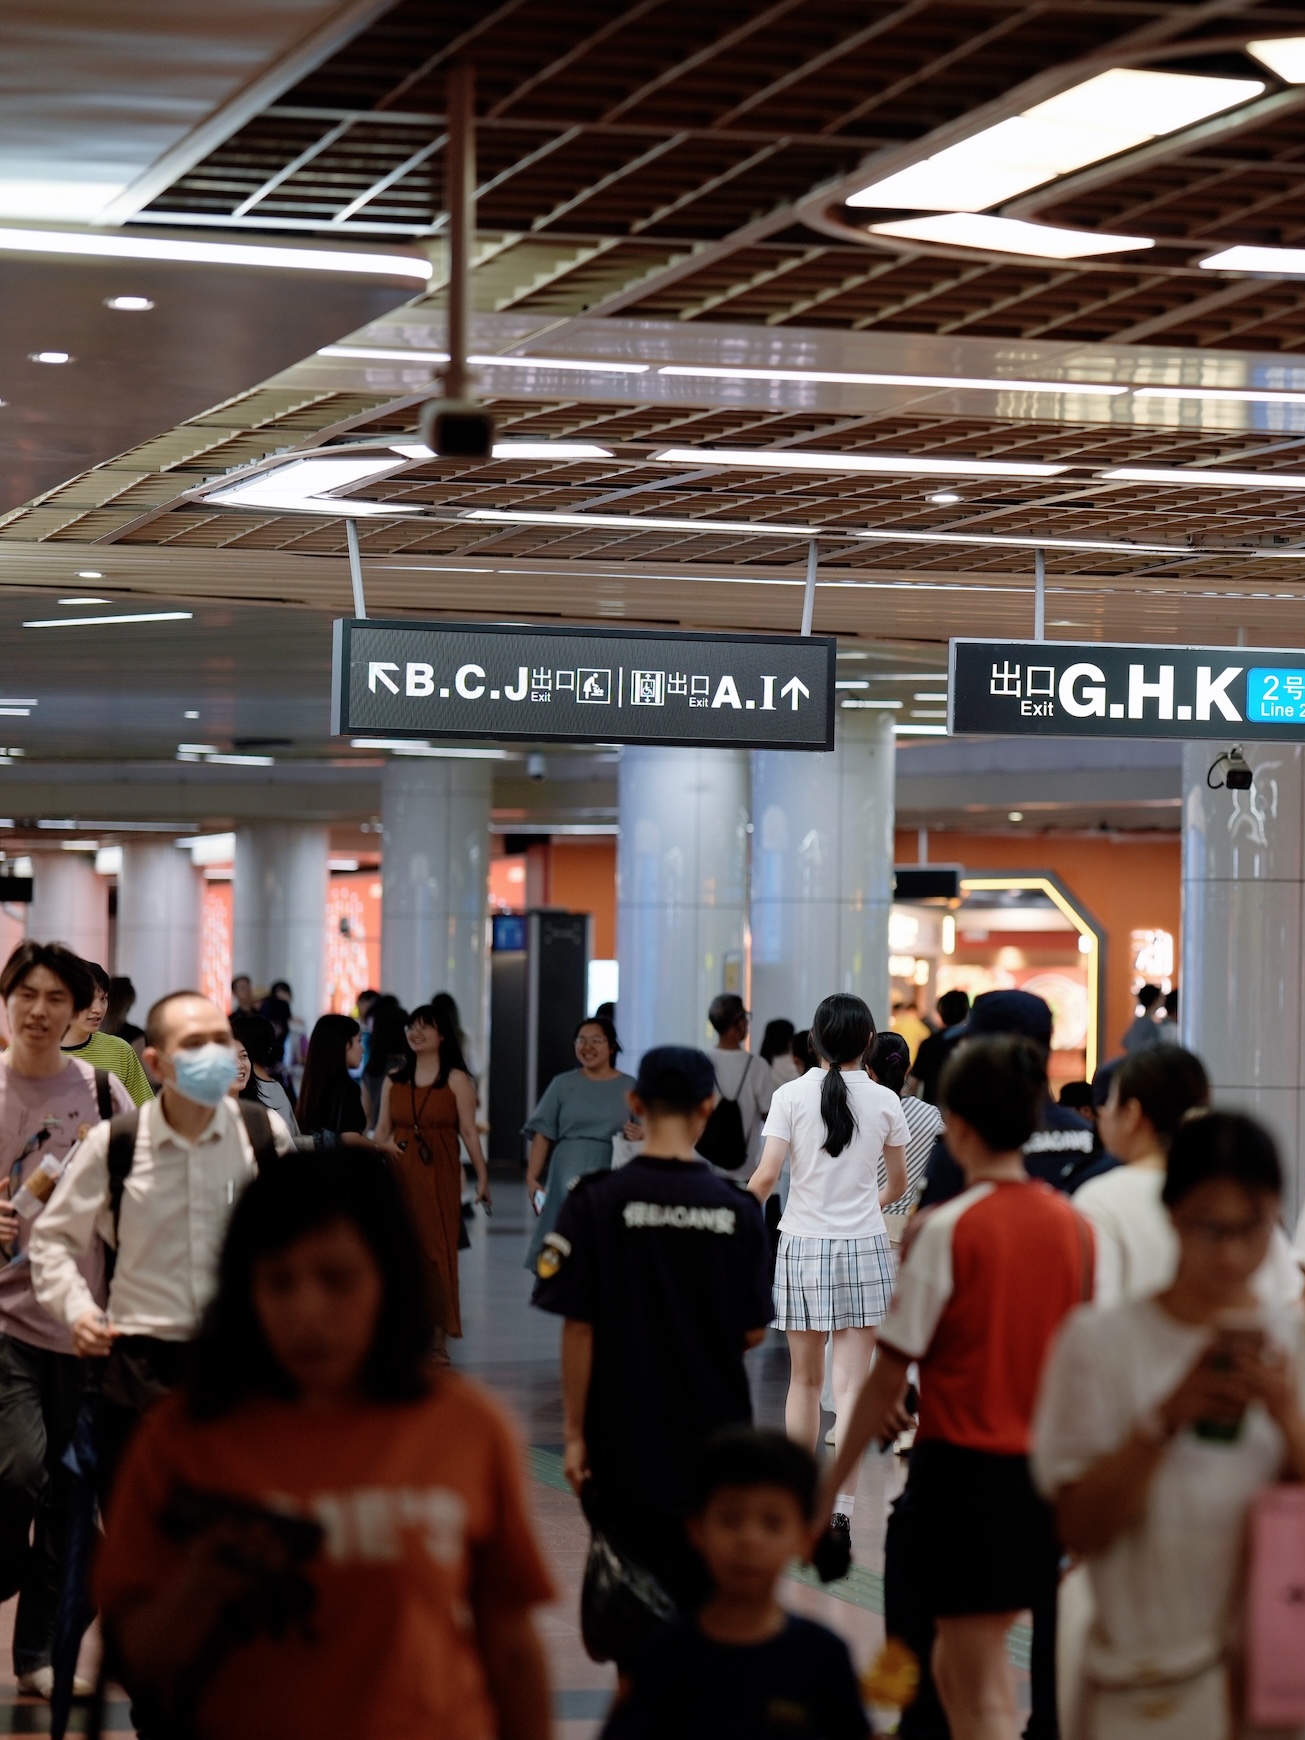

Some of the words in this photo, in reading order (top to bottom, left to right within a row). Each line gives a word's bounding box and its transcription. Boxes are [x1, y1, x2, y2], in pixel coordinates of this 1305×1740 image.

[405, 662, 529, 702] B.C.J
[531, 666, 575, 692] 出口
[667, 671, 710, 696] 出口
[990, 660, 1055, 698] 出口
[530, 692, 552, 703] Exit
[688, 696, 709, 708] Exit
[711, 675, 778, 711] A.I
[1058, 662, 1244, 722] G.H.K
[1020, 700, 1054, 717] Exit
[1261, 703, 1295, 718] Line
